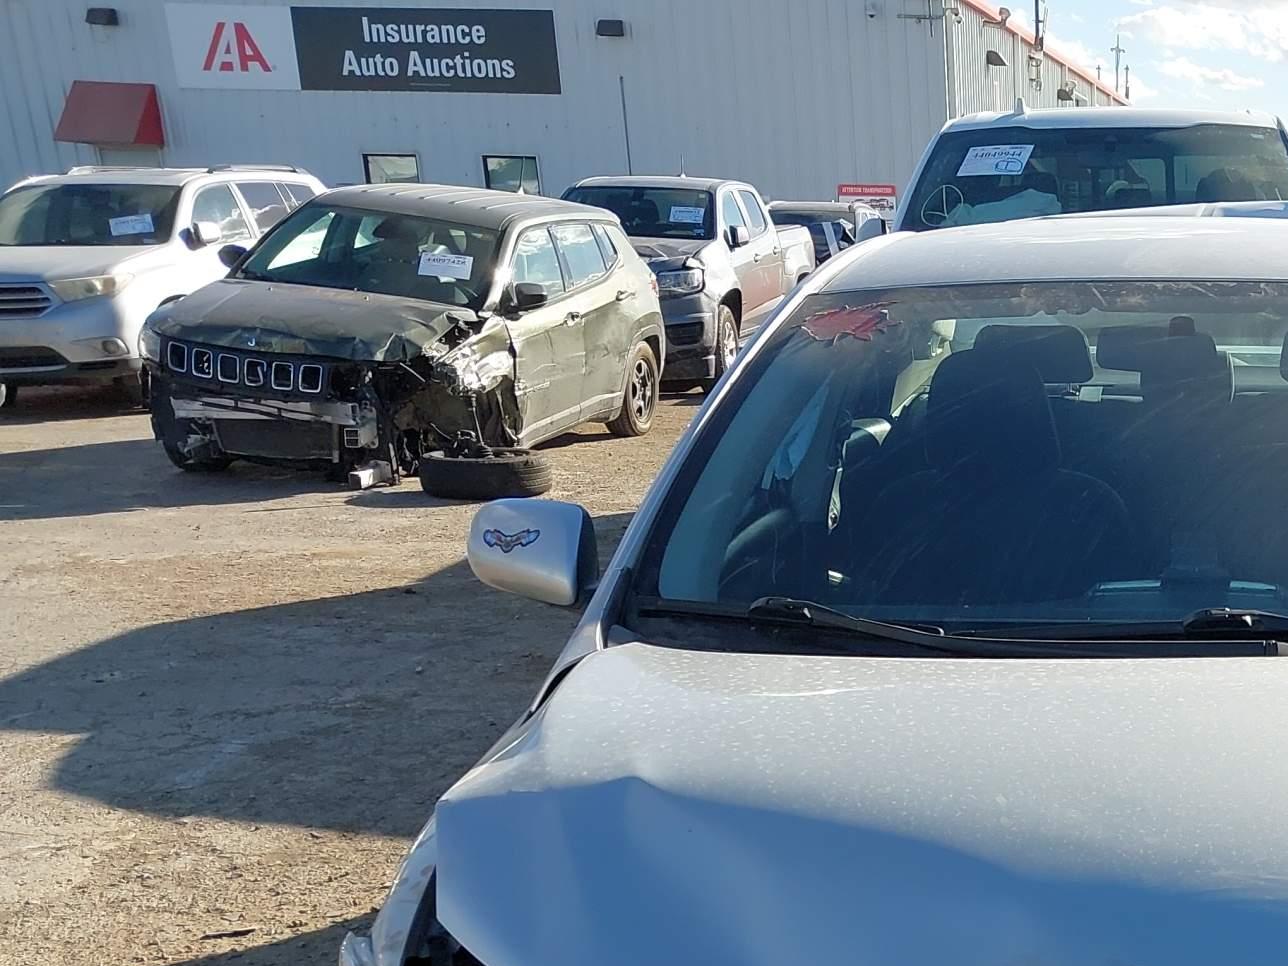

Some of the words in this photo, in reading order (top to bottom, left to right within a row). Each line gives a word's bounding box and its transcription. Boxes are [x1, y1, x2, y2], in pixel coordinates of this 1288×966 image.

[362, 17, 485, 44] Insurance
[342, 50, 399, 77] Auto
[408, 50, 516, 79] Auctions
